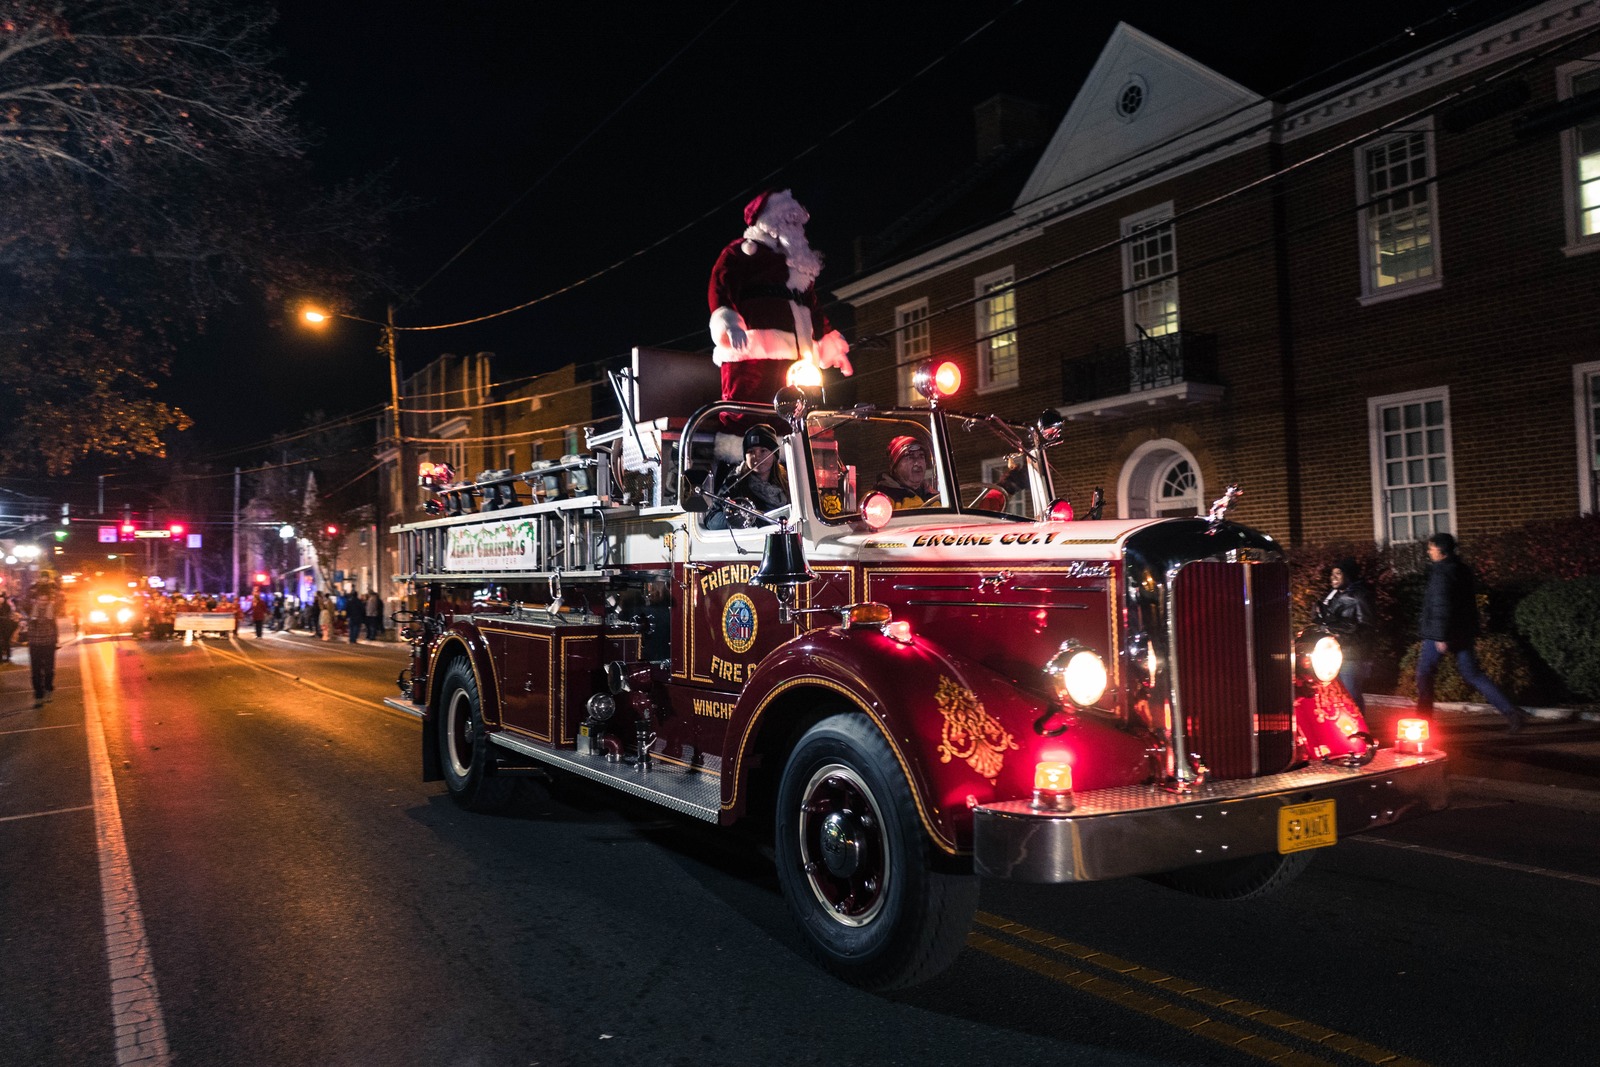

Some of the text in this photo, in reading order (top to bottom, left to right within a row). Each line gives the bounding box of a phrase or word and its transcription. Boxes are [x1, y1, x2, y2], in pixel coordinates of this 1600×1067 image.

[477, 538, 526, 557] CHRISTMAS
[913, 532, 996, 547] ENGINE
[710, 655, 743, 683] FIRE
